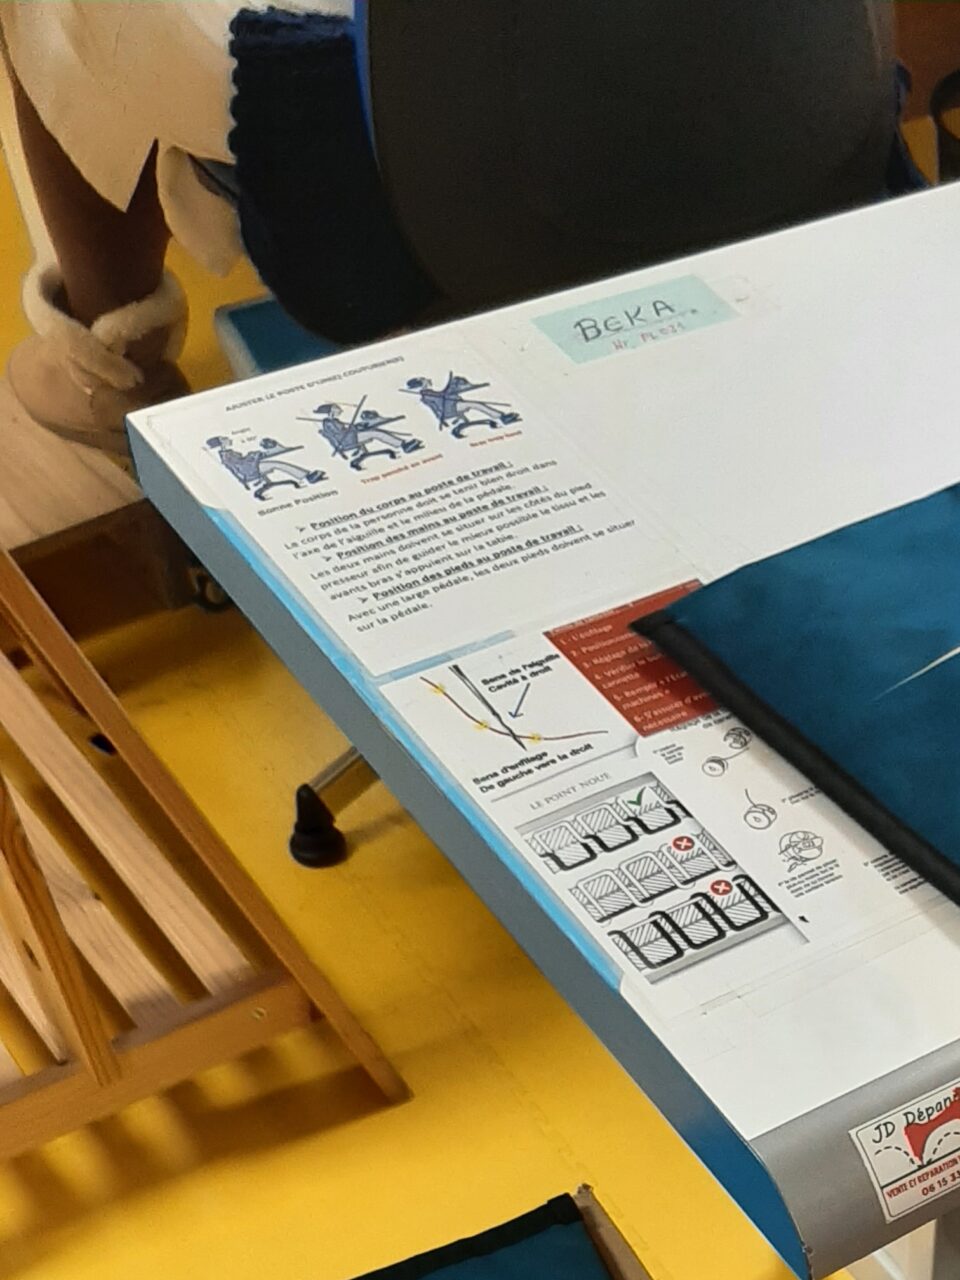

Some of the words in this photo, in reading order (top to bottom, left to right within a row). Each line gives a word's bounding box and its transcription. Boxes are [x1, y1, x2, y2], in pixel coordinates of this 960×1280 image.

[574, 300, 675, 343] BEKA
[284, 542, 299, 550] Le
[300, 532, 333, 546] corps
[332, 526, 348, 534] de
[361, 505, 415, 526] personne
[413, 496, 438, 507] doit
[452, 483, 479, 495] tenir
[479, 475, 505, 486] bien
[504, 467, 532, 479] droit
[531, 459, 557, 470] dans
[294, 489, 339, 505] Position
[312, 512, 358, 530] Position
[358, 506, 375, 515] du
[375, 497, 408, 510] corps
[423, 480, 457, 495] poste
[456, 475, 472, 483] de
[472, 463, 507, 478] travail
[292, 547, 321, 560] l'axe
[321, 541, 337, 550] de
[337, 526, 386, 546] l'aiguille
[385, 521, 399, 529] et
[411, 505, 447, 520] milieu
[447, 500, 462, 509] de
[475, 483, 517, 500] pédale.
[310, 569, 332, 580] Les
[331, 560, 360, 573] deux
[360, 548, 396, 563] mains
[395, 533, 440, 551] doivent
[454, 517, 487, 531] situer
[488, 512, 506, 520] sur
[505, 505, 523, 514] les
[523, 495, 553, 508] côtés
[553, 490, 568, 499] du
[568, 482, 594, 495] pied
[320, 571, 370, 591] presseur
[370, 562, 394, 573] afin
[393, 556, 410, 565] de
[410, 543, 449, 561] guider
[447, 539, 460, 547] le
[459, 528, 495, 543] mieux
[495, 512, 541, 532] possible
[539, 508, 552, 516] le
[551, 500, 578, 512] tissu
[576, 495, 590, 503] et
[589, 490, 606, 499] les
[336, 540, 385, 559] Position
[384, 532, 406, 543] des
[405, 520, 442, 536] mains
[457, 504, 491, 520] poste
[490, 499, 506, 508] de
[505, 487, 542, 503] travail
[328, 584, 367, 600] avants
[367, 575, 394, 587] bras
[394, 555, 455, 579] s'appuient
[455, 549, 473, 557] sur
[486, 533, 518, 547] table.
[346, 607, 376, 621] Avec
[377, 600, 401, 611] une
[400, 589, 433, 604] large
[431, 574, 475, 594] pédale,
[473, 568, 492, 578] les
[491, 558, 520, 572] deux
[520, 548, 552, 563] pieds
[550, 534, 592, 552] doivent
[605, 518, 637, 533] situer
[372, 579, 422, 600] Position
[421, 572, 443, 583] des
[443, 560, 476, 576] pieds
[476, 556, 491, 565] au
[491, 544, 525, 559] poste
[524, 538, 541, 548] de
[540, 526, 577, 542] travail
[356, 622, 376, 632] sur
[376, 616, 389, 625] la
[388, 601, 434, 621] pédale.
[481, 673, 507, 687] Sens
[508, 666, 522, 677] de
[488, 677, 519, 694] Cavité
[529, 665, 553, 679] droit
[472, 770, 499, 786] Sens
[500, 750, 549, 775] d'enfilage
[479, 783, 496, 794] De
[496, 767, 535, 789] gauche
[534, 759, 558, 771] vers
[557, 752, 569, 763] la
[569, 742, 594, 757] droit
[529, 798, 543, 811] LE
[543, 784, 579, 806] POINT
[872, 1120, 896, 1144] JD
[886, 1183, 909, 1199] VENTE
[908, 1179, 918, 1189] ET
[921, 1182, 936, 1197] 06
[936, 1177, 949, 1188] 15
